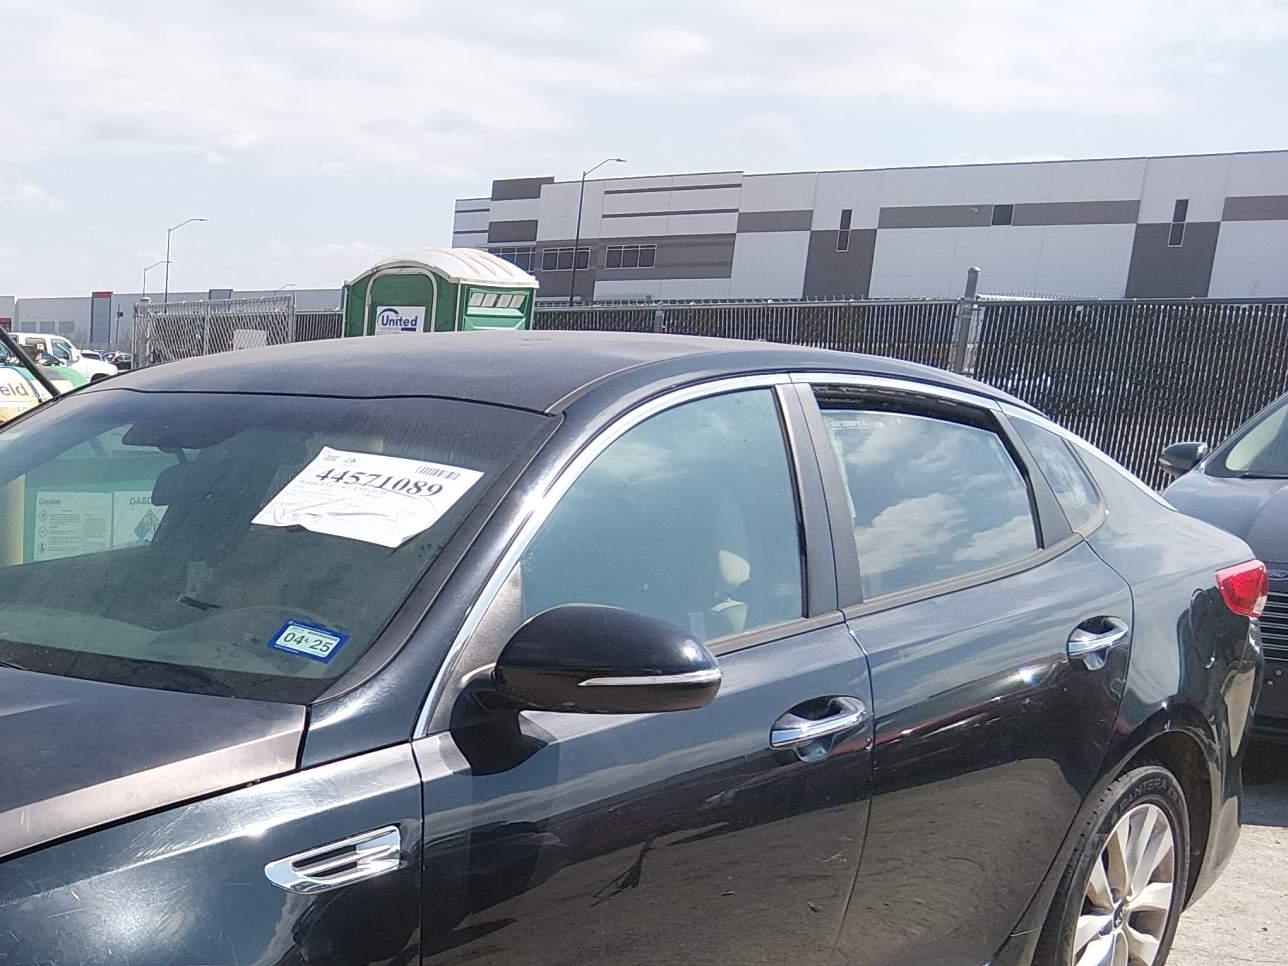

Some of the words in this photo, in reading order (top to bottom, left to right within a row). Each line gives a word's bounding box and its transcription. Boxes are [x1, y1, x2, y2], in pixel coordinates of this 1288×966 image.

[381, 315, 418, 327] United
[315, 467, 444, 497] 44571089
[283, 632, 305, 645] 04
[309, 639, 333, 653] 25
